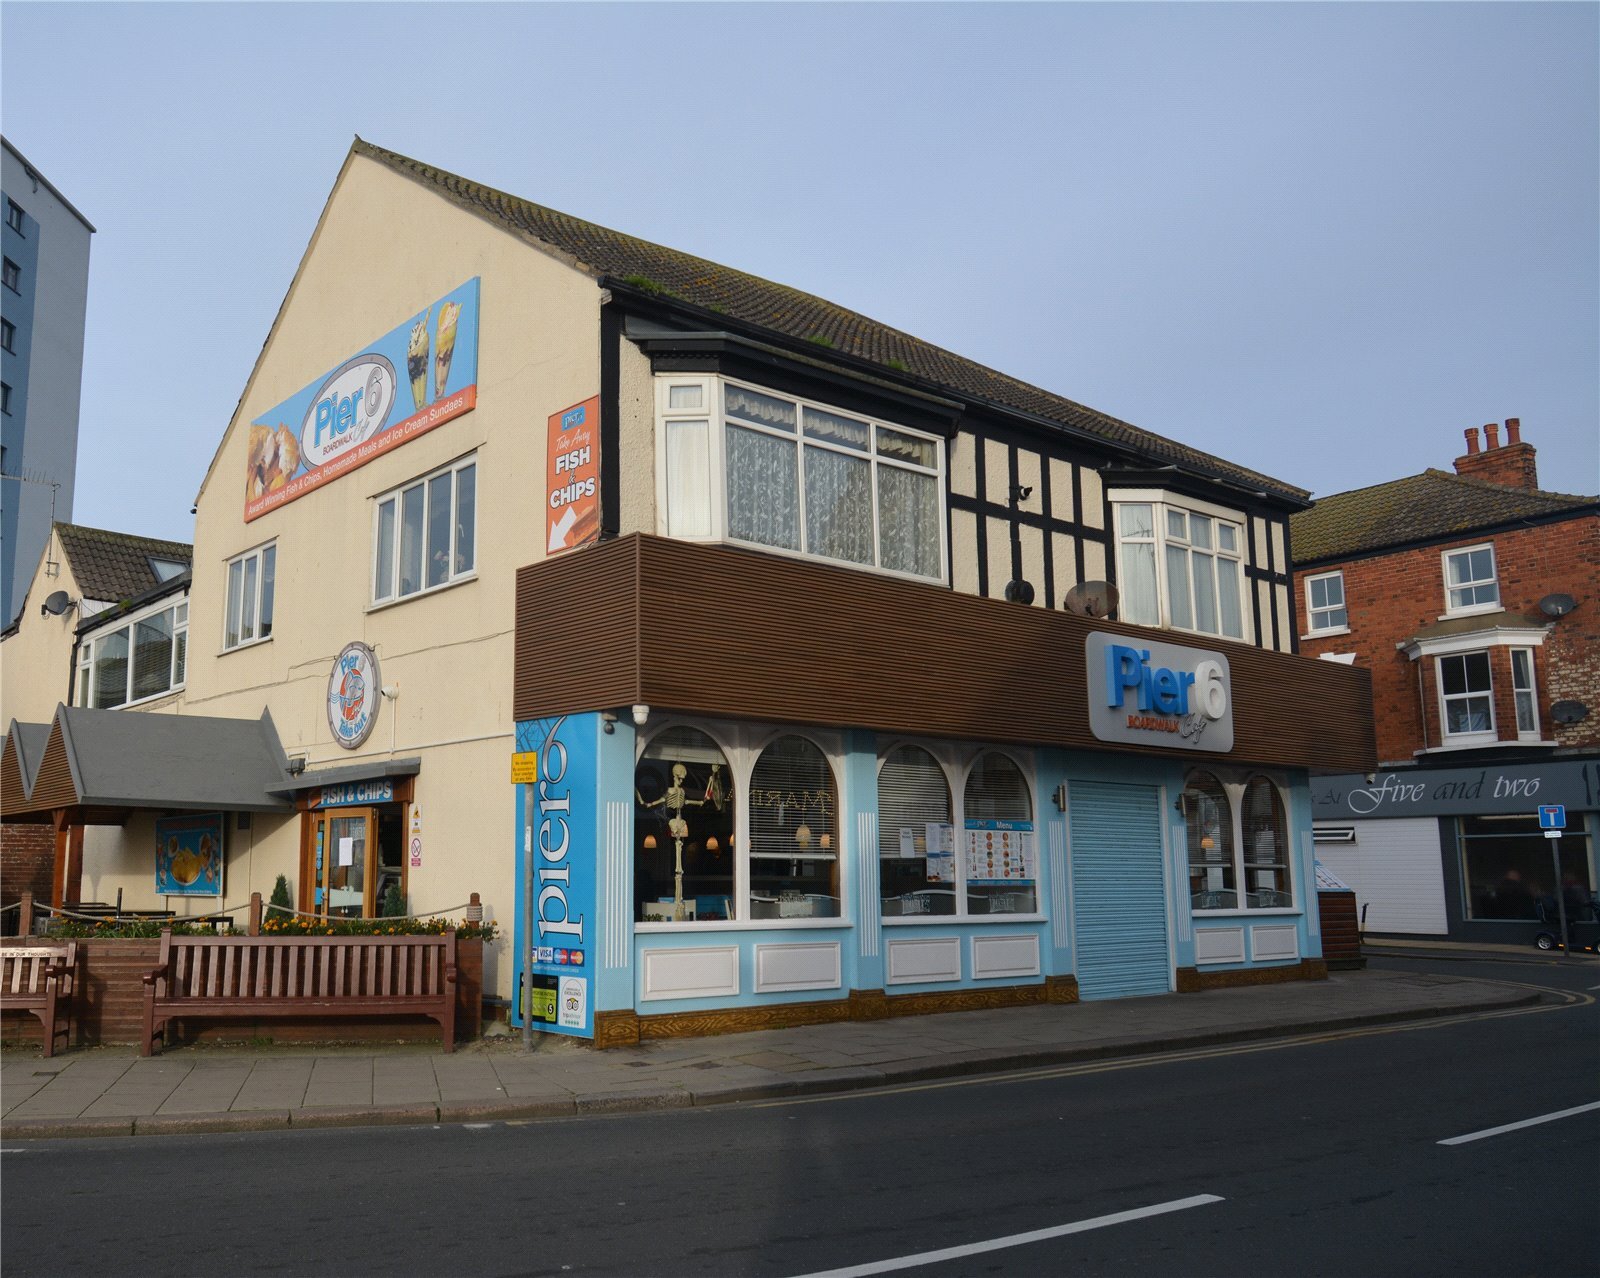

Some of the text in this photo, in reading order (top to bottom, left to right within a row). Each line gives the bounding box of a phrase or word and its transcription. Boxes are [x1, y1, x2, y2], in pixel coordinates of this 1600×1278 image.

[314, 366, 383, 448] Pier 6
[322, 432, 353, 456] BOARDWALK
[556, 429, 591, 451] Take Away
[248, 499, 265, 515] Award
[264, 490, 286, 507] Winning
[286, 482, 298, 496] Fish
[323, 452, 357, 477] Homemade
[358, 443, 377, 458] Meals
[378, 433, 391, 448] and
[392, 429, 402, 440] Ice
[404, 415, 428, 434] Cream
[429, 397, 463, 421] Sundaes
[555, 445, 591, 475] FISH
[550, 477, 596, 509] CHIPS
[340, 654, 359, 676] Pier
[1105, 644, 1226, 719] Pier 6
[1127, 714, 1180, 734] BOARDWALK
[321, 780, 392, 805] FISH & CHIPS
[1433, 771, 1487, 800] and
[1493, 775, 1541, 799] two
[996, 821, 1013, 829] Menu
[540, 949, 552, 958] VISA
